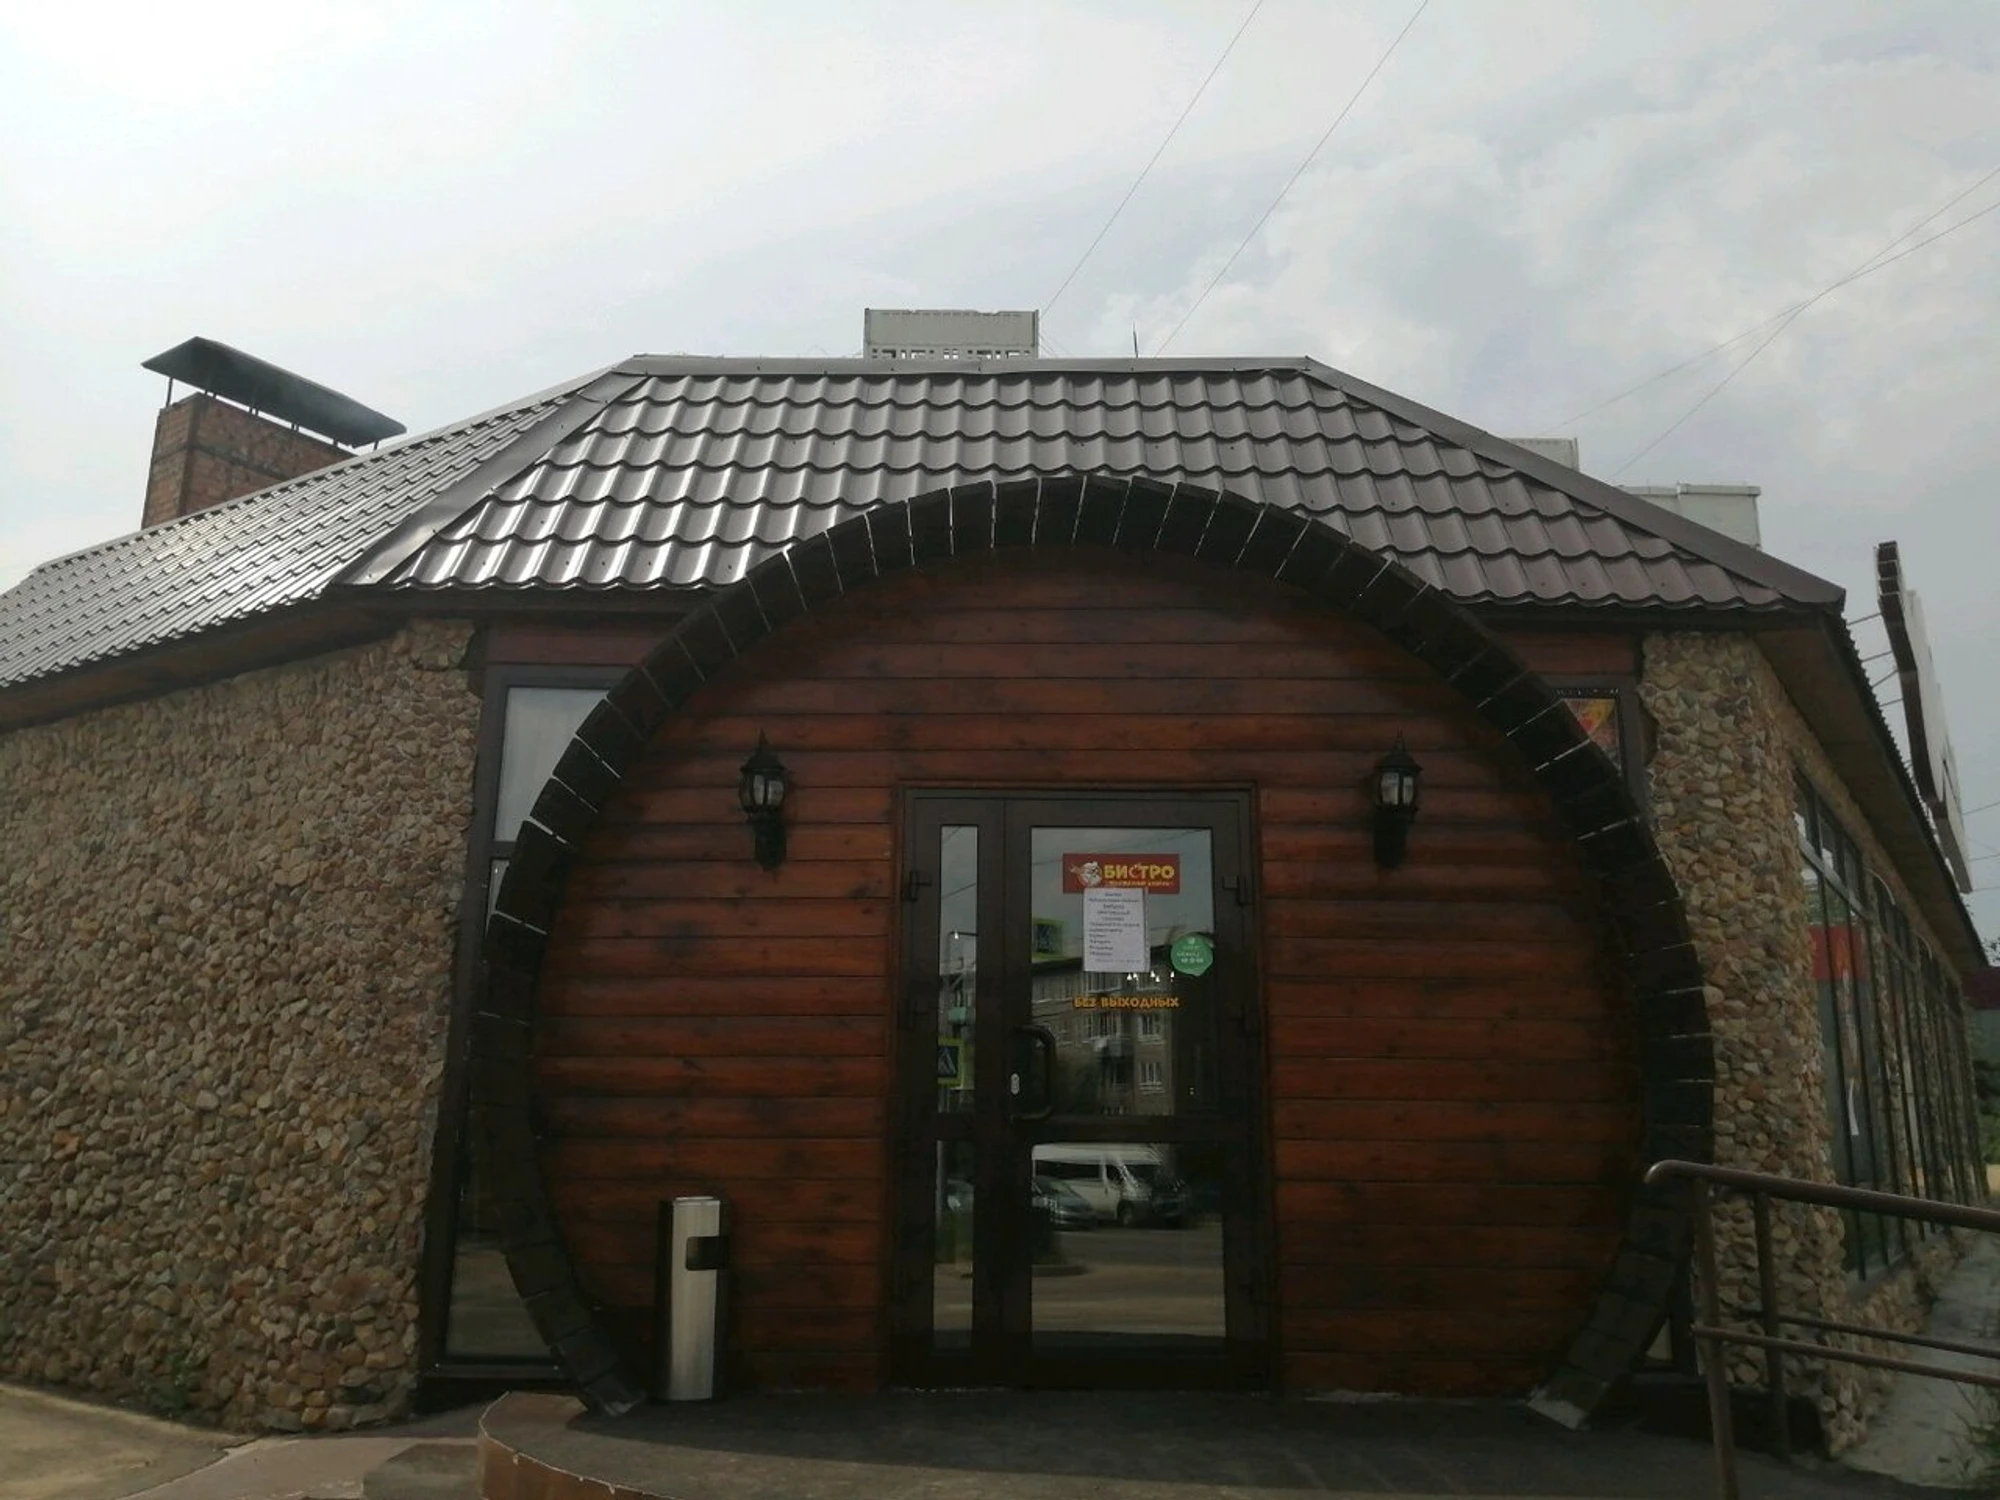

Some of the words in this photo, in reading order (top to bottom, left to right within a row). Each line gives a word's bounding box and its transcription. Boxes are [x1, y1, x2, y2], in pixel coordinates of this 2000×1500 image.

[1104, 864, 1175, 879] БИСТРО
[1075, 997, 1097, 1008] БЕЗ
[1101, 997, 1180, 1008] ВЫХОДНЫХ
